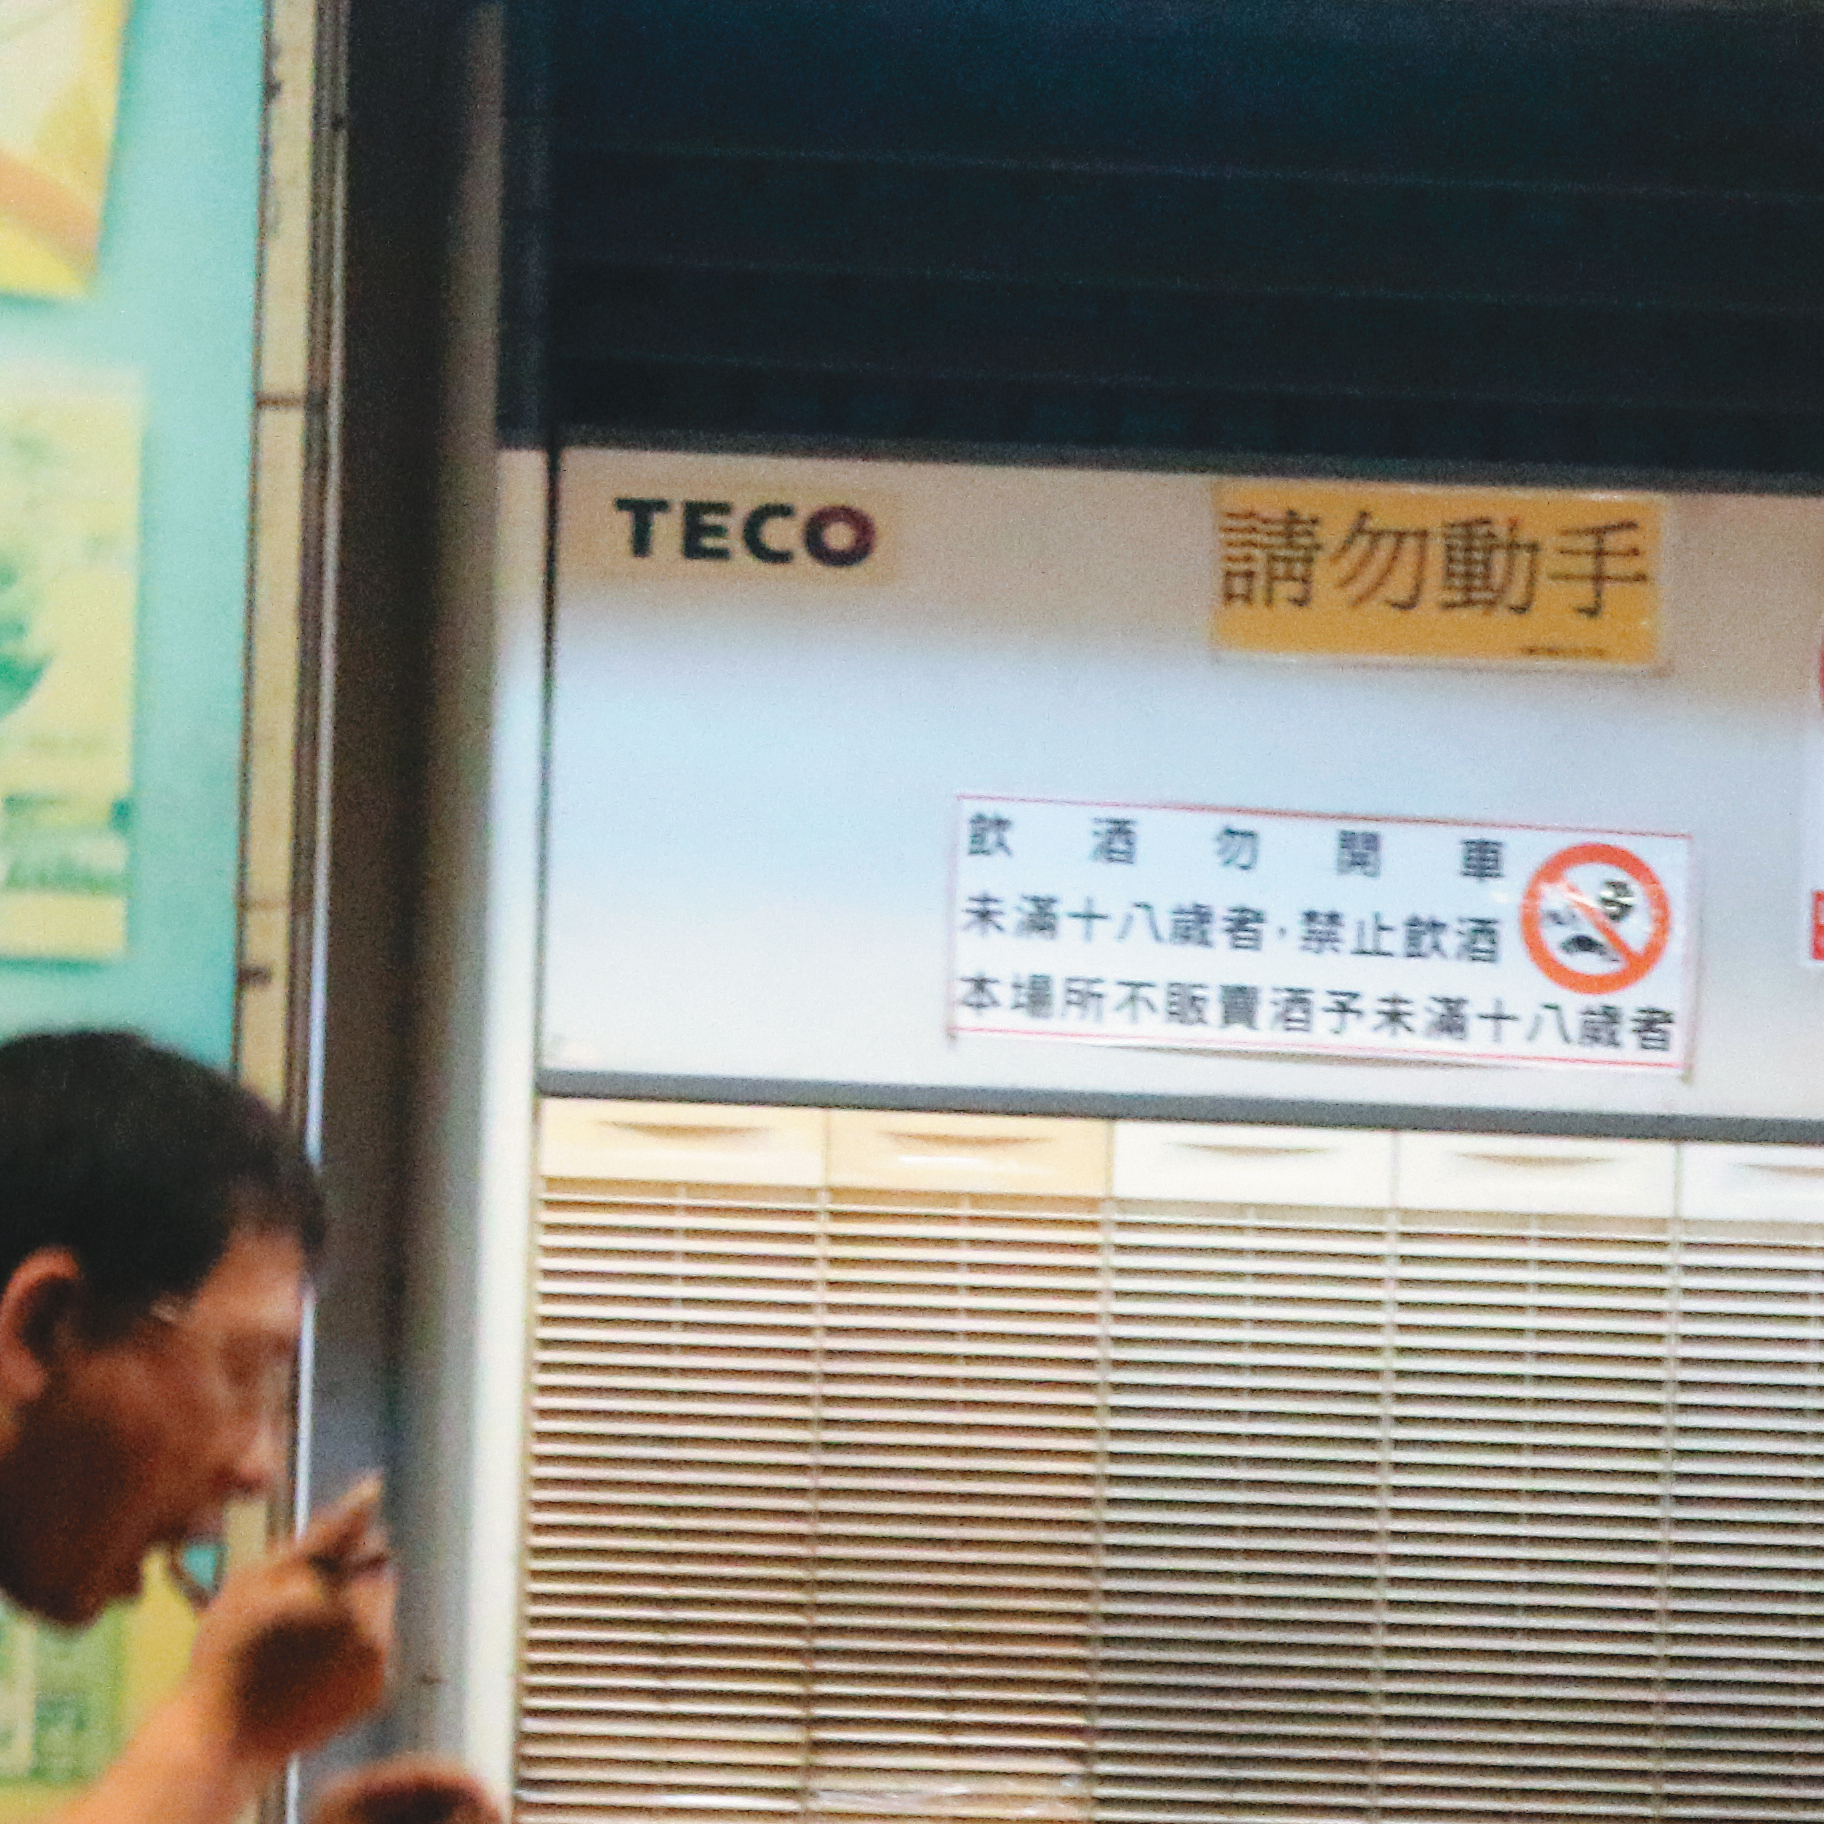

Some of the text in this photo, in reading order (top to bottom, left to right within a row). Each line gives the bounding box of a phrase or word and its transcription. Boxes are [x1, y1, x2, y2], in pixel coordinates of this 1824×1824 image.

[615, 497, 877, 568] TECO
[1219, 509, 1648, 617] 請勿動手
